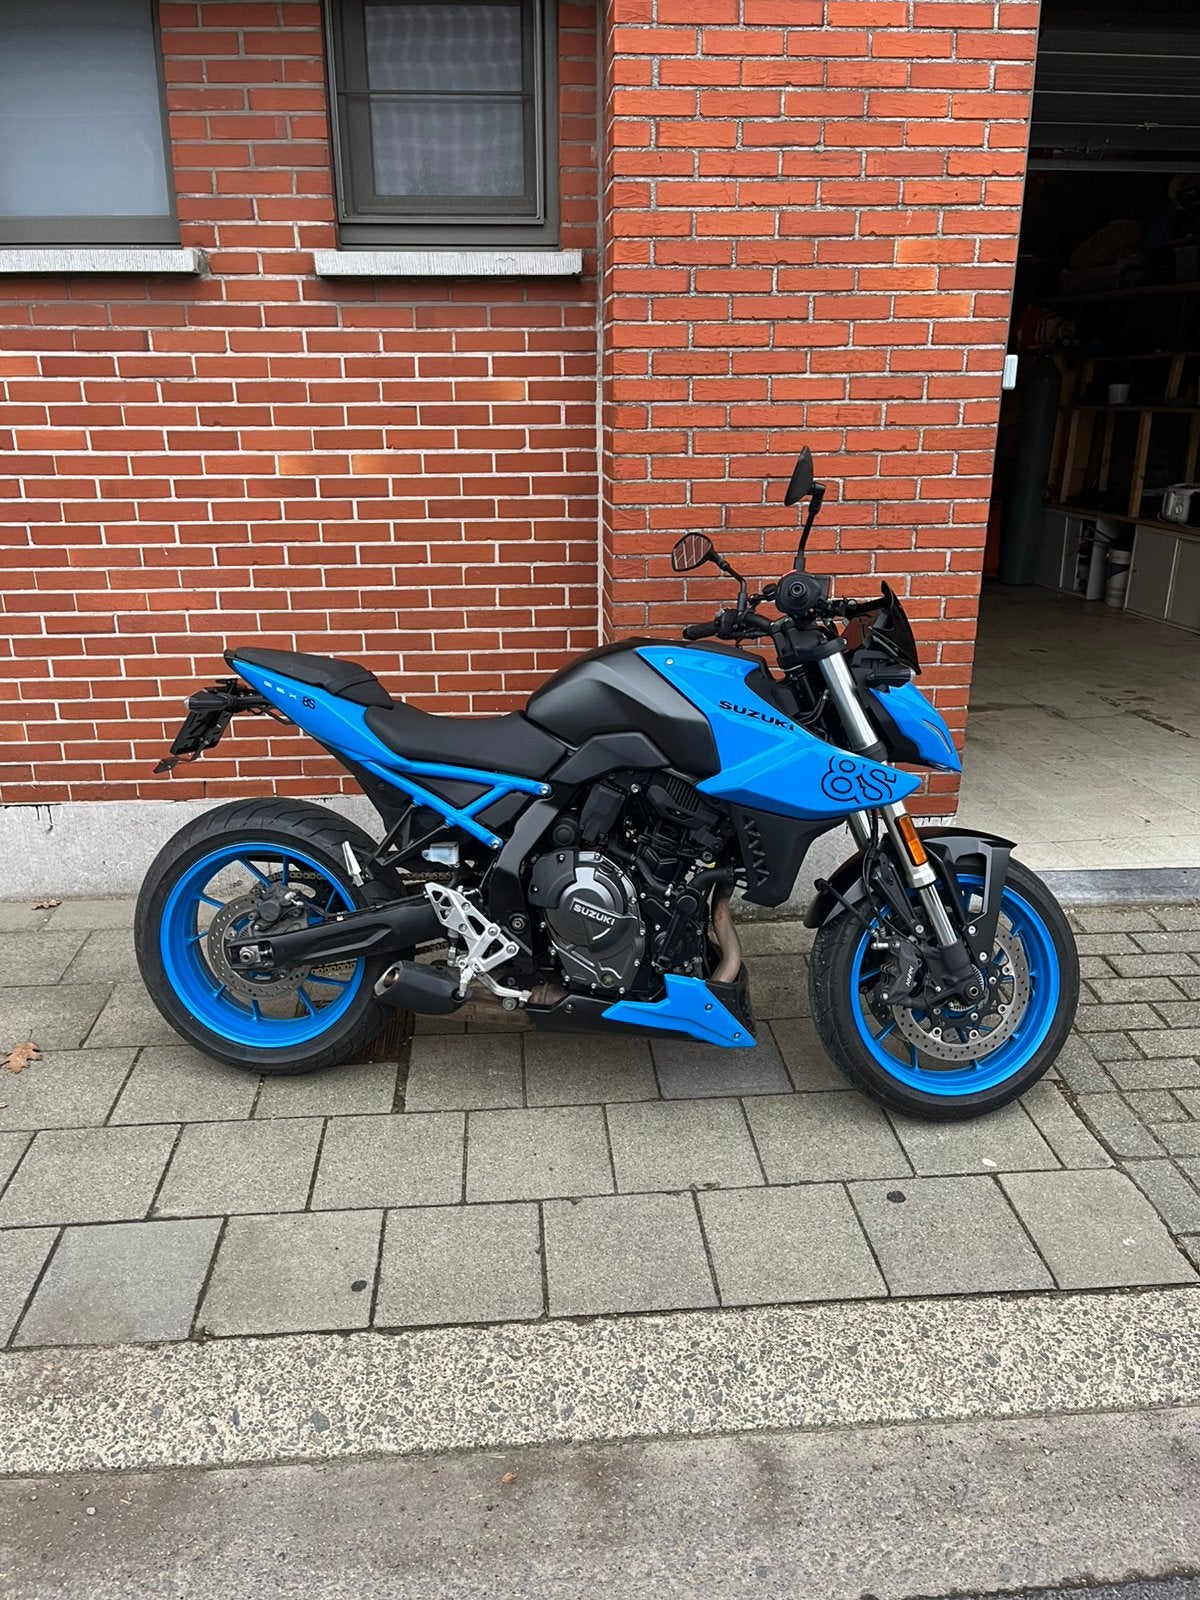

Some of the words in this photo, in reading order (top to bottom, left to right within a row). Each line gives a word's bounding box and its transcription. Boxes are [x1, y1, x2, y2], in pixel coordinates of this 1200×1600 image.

[719, 700, 795, 731] SUZUKI
[820, 755, 897, 805] 8S
[573, 904, 616, 926] SUZUKI
